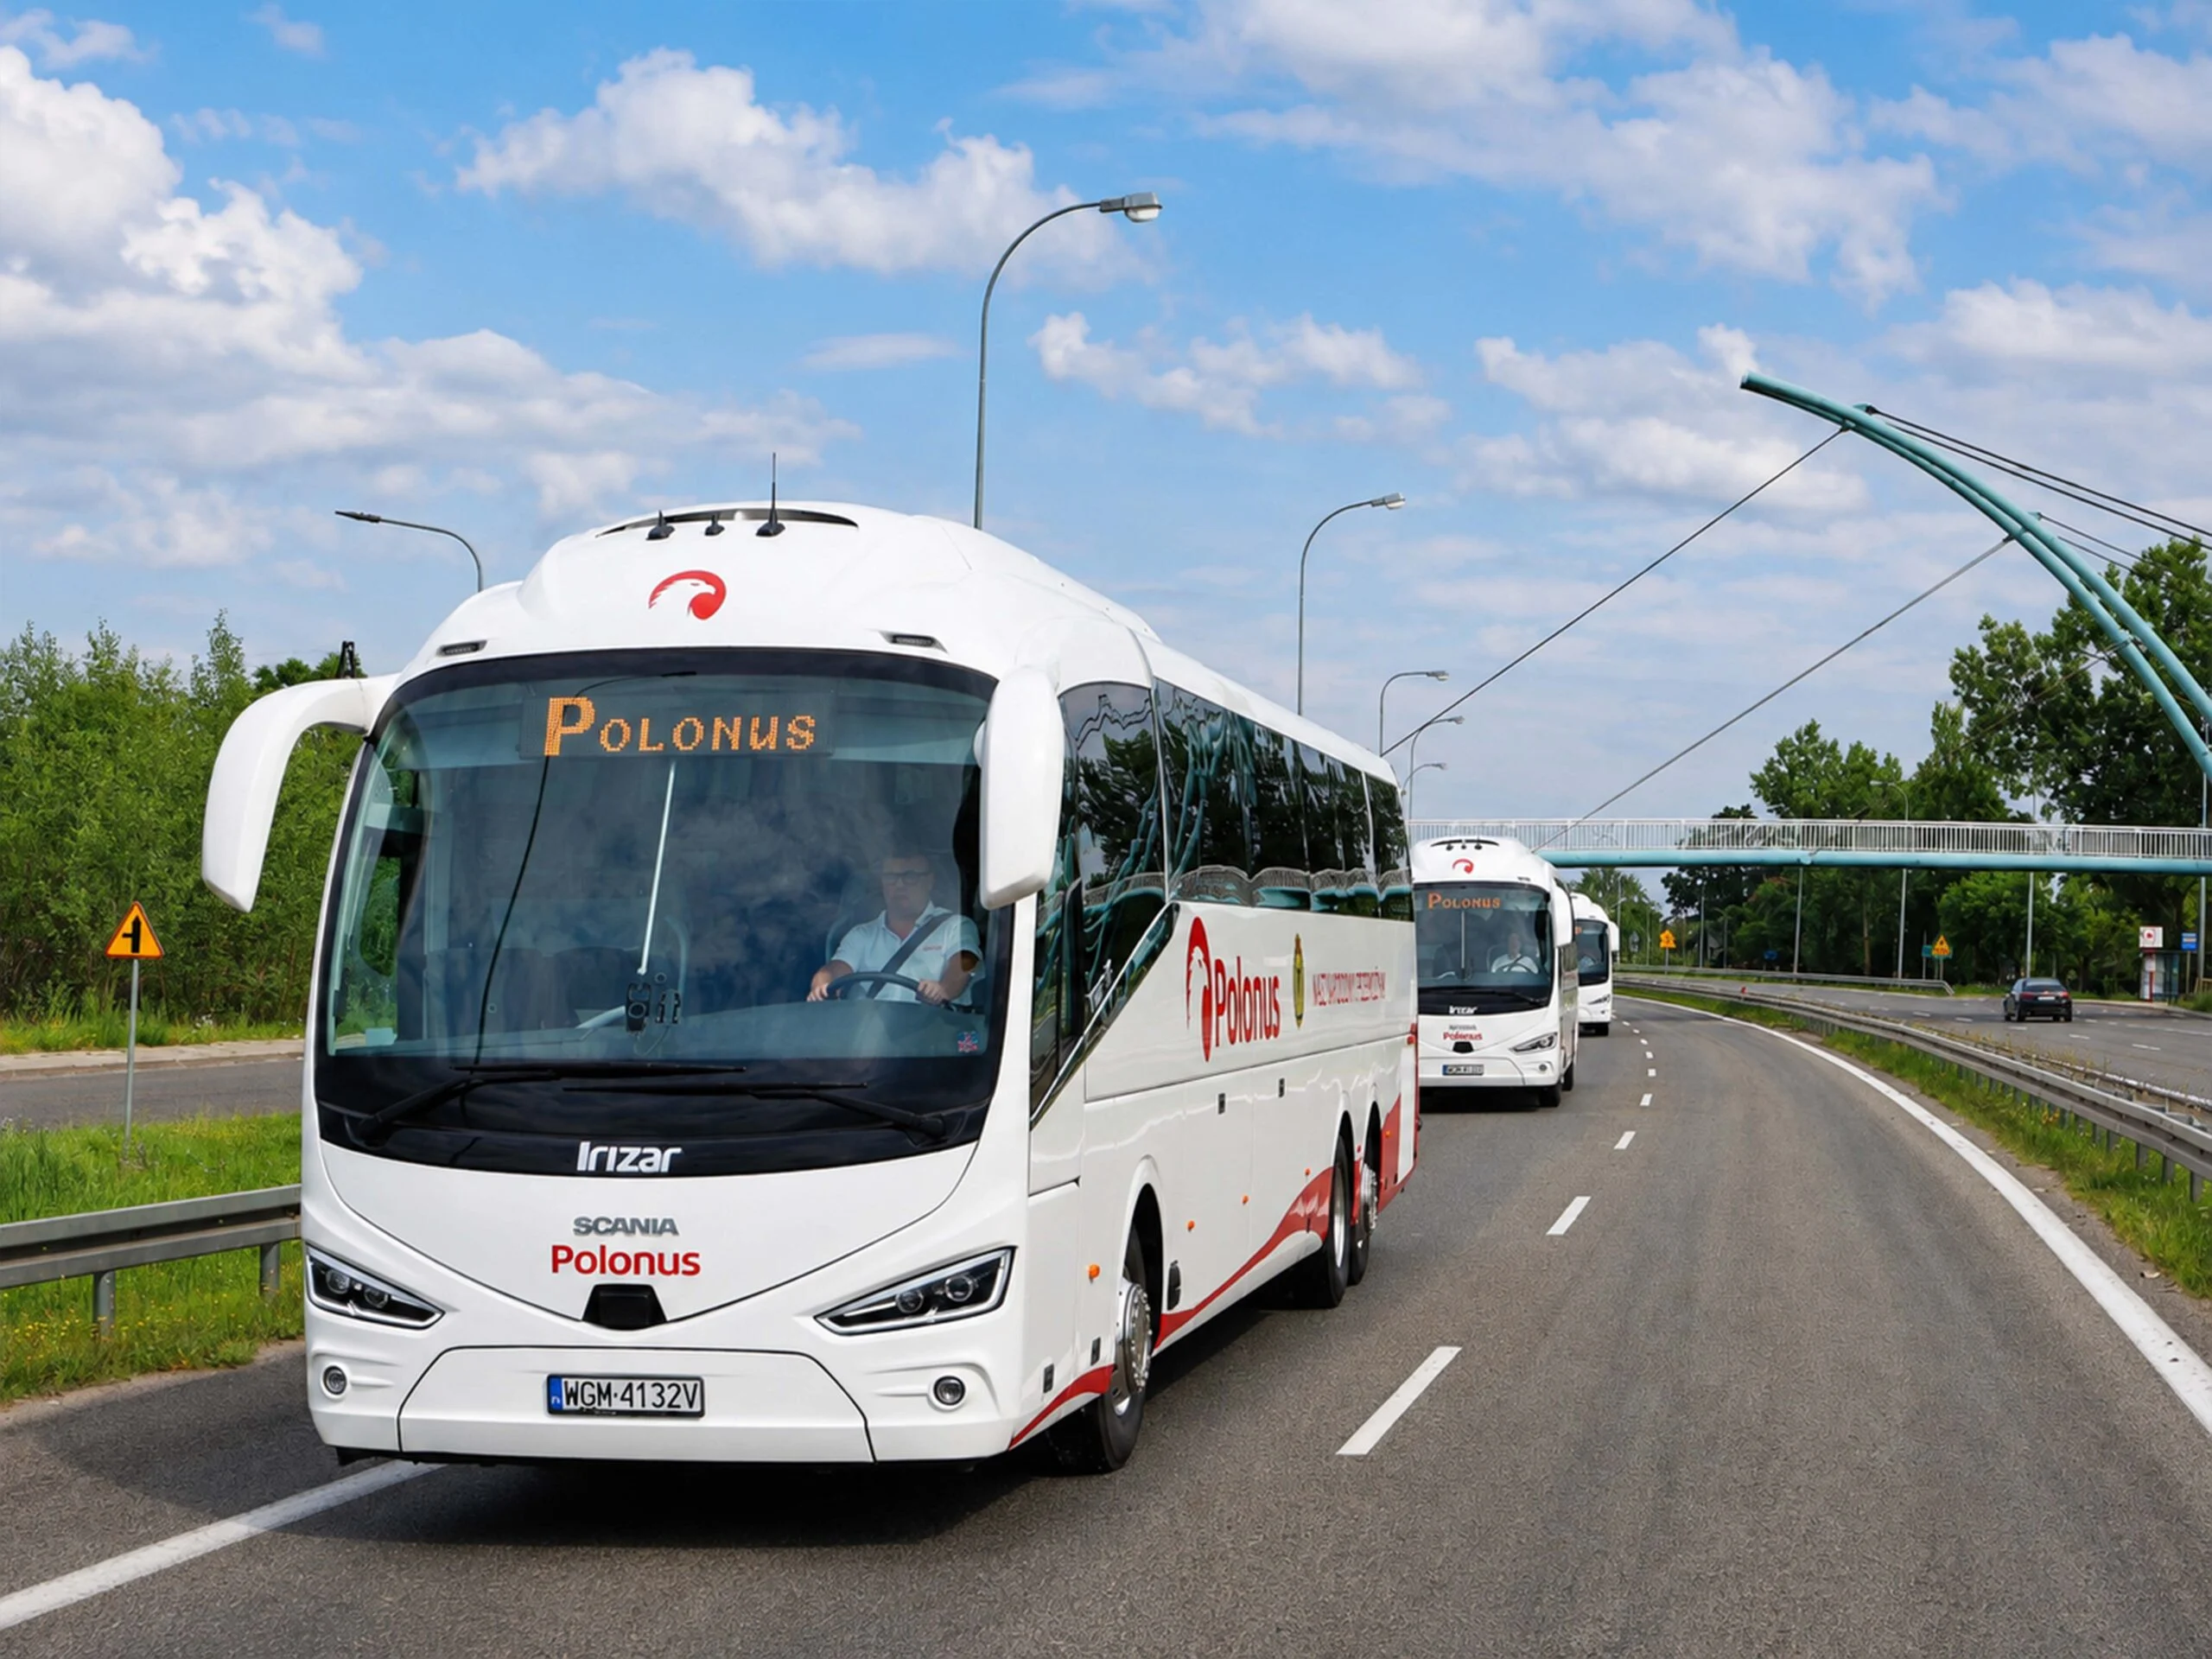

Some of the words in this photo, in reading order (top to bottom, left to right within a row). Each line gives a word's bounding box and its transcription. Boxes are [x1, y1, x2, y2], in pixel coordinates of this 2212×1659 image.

[543, 697, 817, 757] POLONUS
[1214, 956, 1281, 1047] Polonus
[576, 1141, 683, 1173] Irizar
[573, 1217, 679, 1236] SCANIA
[551, 1244, 701, 1276] Polonus
